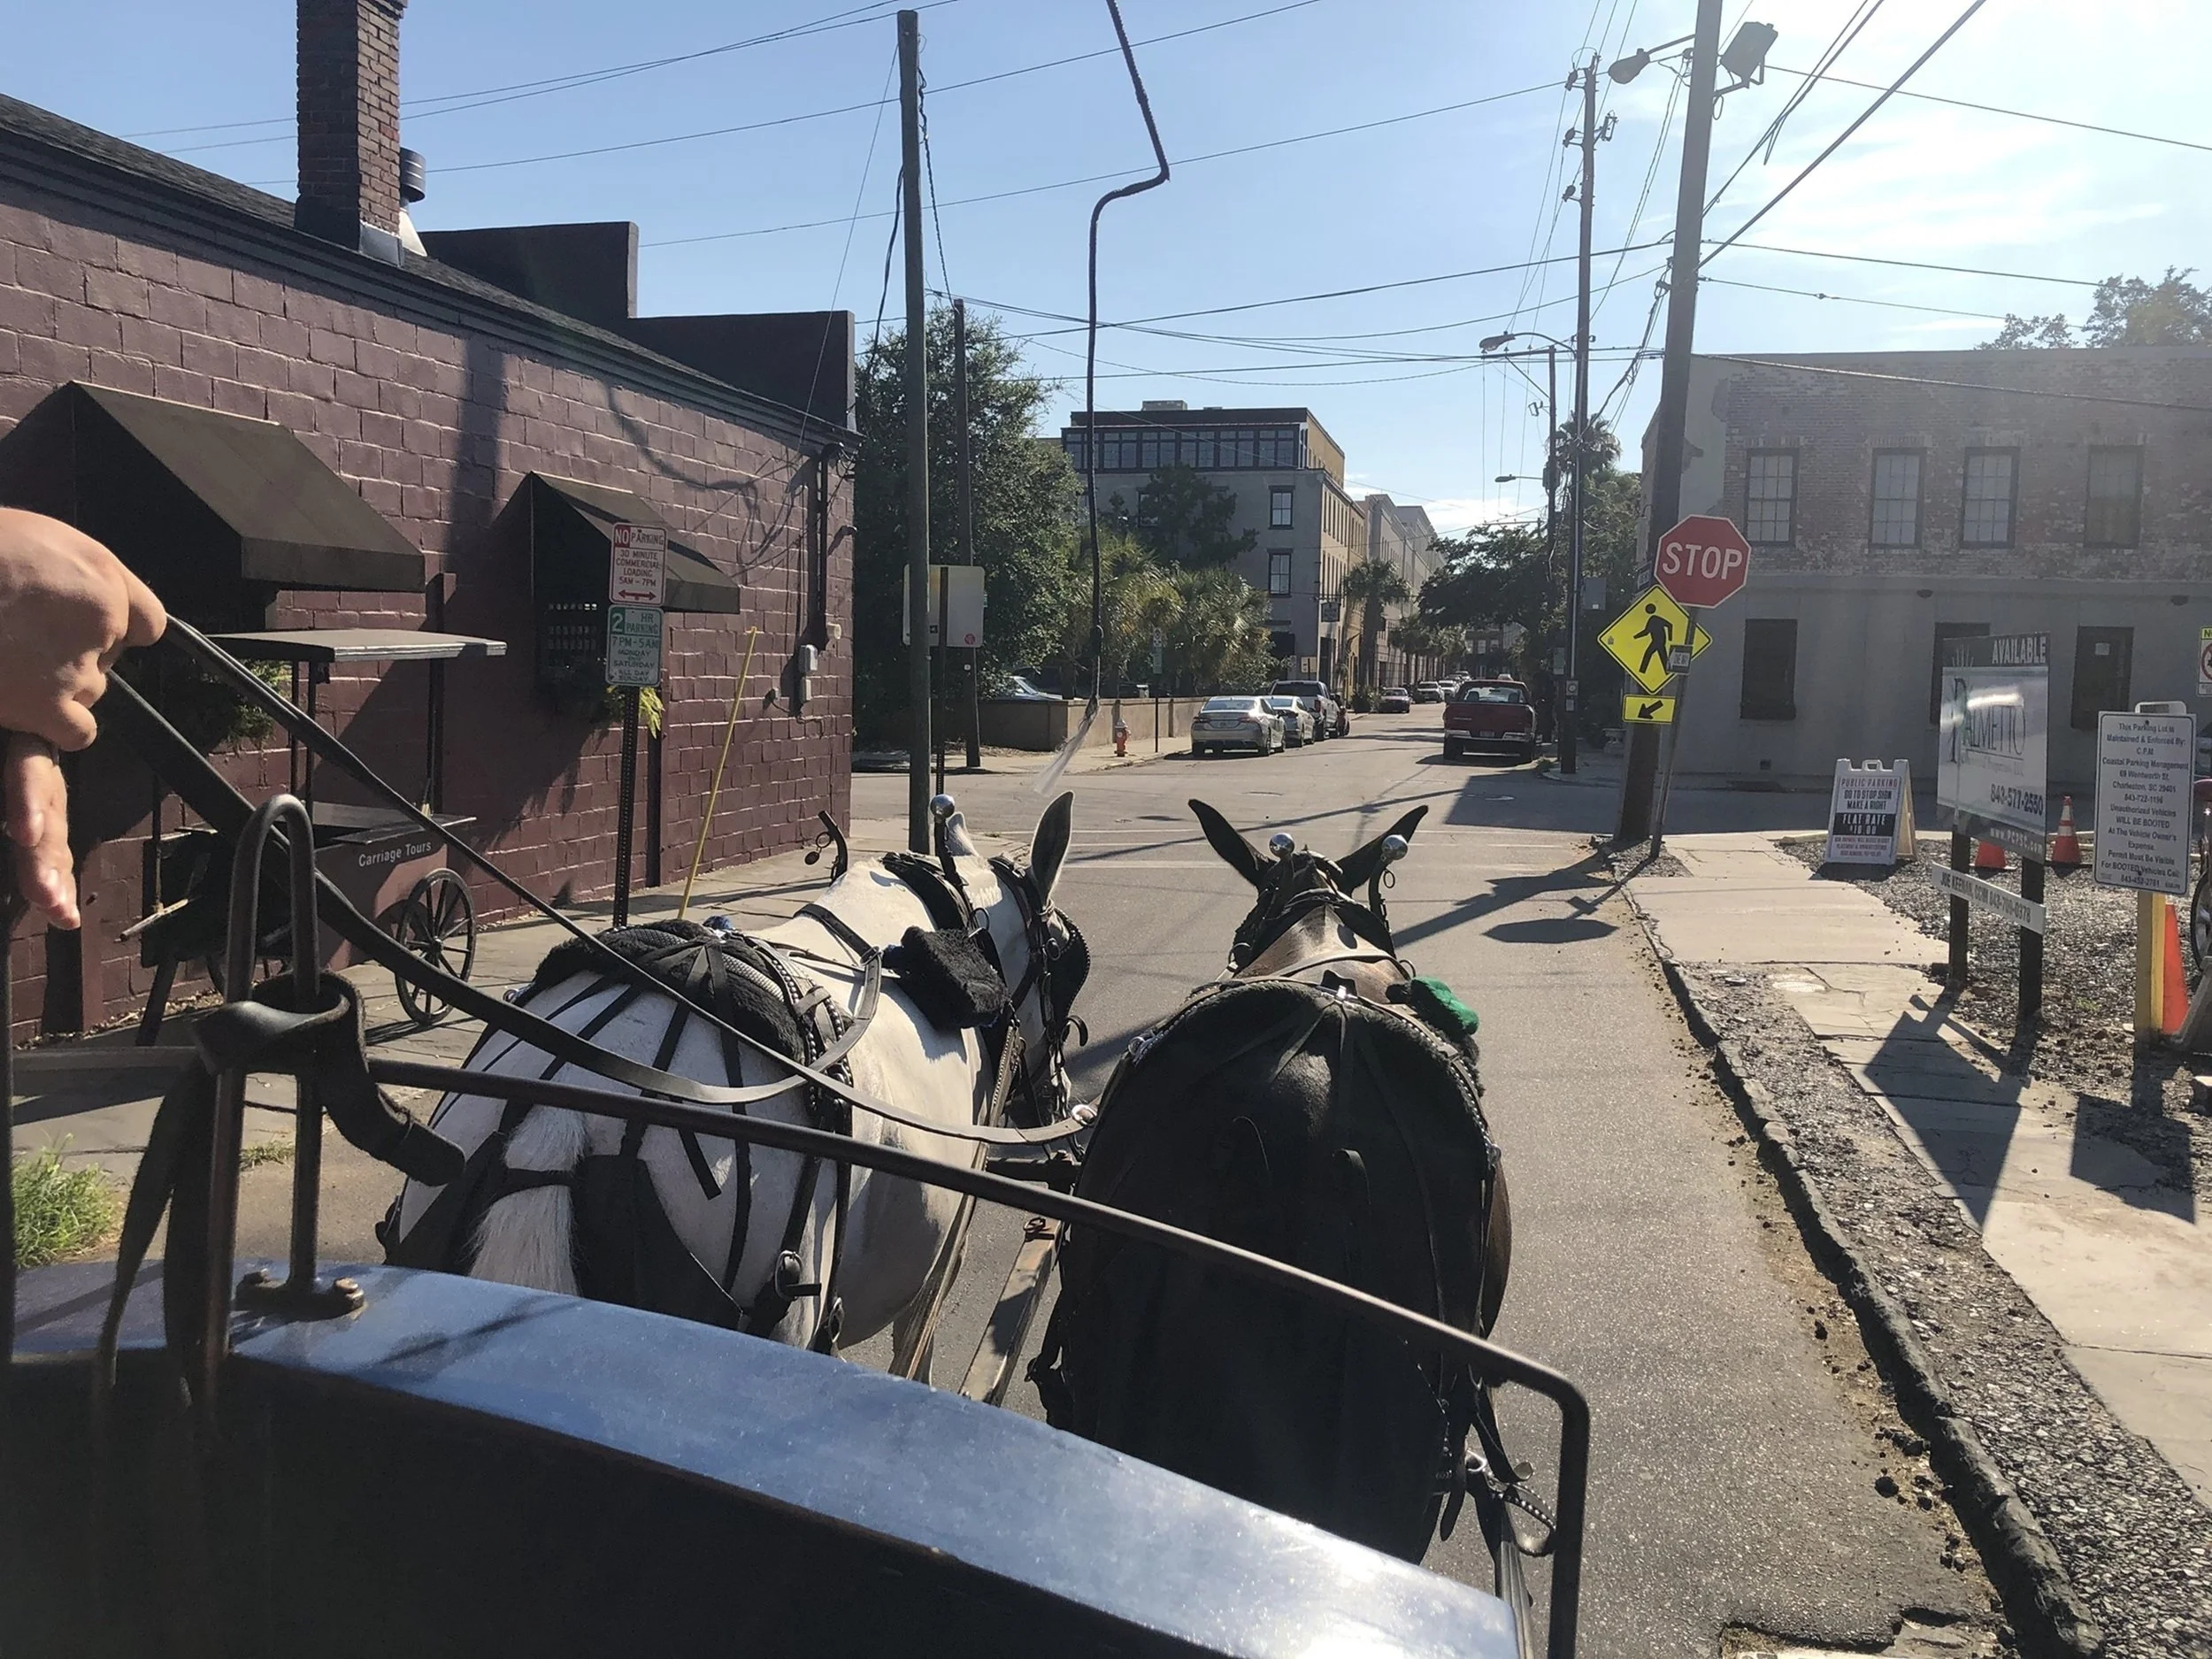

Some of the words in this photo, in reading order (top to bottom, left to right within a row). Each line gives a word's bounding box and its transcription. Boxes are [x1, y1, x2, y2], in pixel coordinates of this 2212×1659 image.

[615, 528, 629, 544] NO
[631, 533, 664, 545] PARKING
[633, 551, 658, 560] MINUTE
[1663, 541, 1743, 580] STOP
[616, 558, 659, 569] COMMERCIAL
[623, 568, 652, 577] LOADING
[642, 578, 657, 587] 7PM
[611, 612, 623, 632] 2
[641, 612, 654, 623] HR
[626, 623, 658, 634] PARKING
[618, 649, 652, 657] MONDAY
[1992, 636, 2047, 664] AVAILABLE
[2133, 724, 2156, 733] Parking
[2107, 734, 2139, 743] Maintained
[2147, 736, 2174, 745] Enforced
[2125, 758, 2149, 768] Parking
[2150, 760, 2189, 770] Management
[2128, 770, 2161, 779] Wentworth
[1841, 778, 1864, 787] PUBLIC
[1867, 779, 1898, 787] PARKING
[2112, 780, 2146, 790] Charleston,
[1853, 790, 1861, 799] TO
[1862, 790, 1877, 800] STOP
[1878, 791, 1892, 800] SIGN
[1991, 784, 2044, 818] 843-577-2550
[1847, 801, 1863, 810] MAKE
[1870, 801, 1886, 810] RIGHT
[2110, 803, 2150, 813] Unauthorized
[2151, 807, 2177, 816] Vehicles
[1843, 814, 1863, 825] FLAT
[1865, 814, 1886, 826] RATE
[2116, 816, 2131, 825] WILL
[2143, 818, 2170, 828] BOOTED
[2116, 827, 2128, 836] The
[2129, 829, 2151, 838] Vehicle
[2152, 832, 2177, 841] Owner's
[358, 848, 402, 868] Carriage
[405, 841, 432, 856] Tours
[2108, 849, 2128, 858] Permit
[2155, 856, 2175, 864] Visible
[2112, 862, 2141, 872] BOOTED
[2141, 866, 2165, 876] Vehicles
[1940, 872, 1950, 888] JOE
